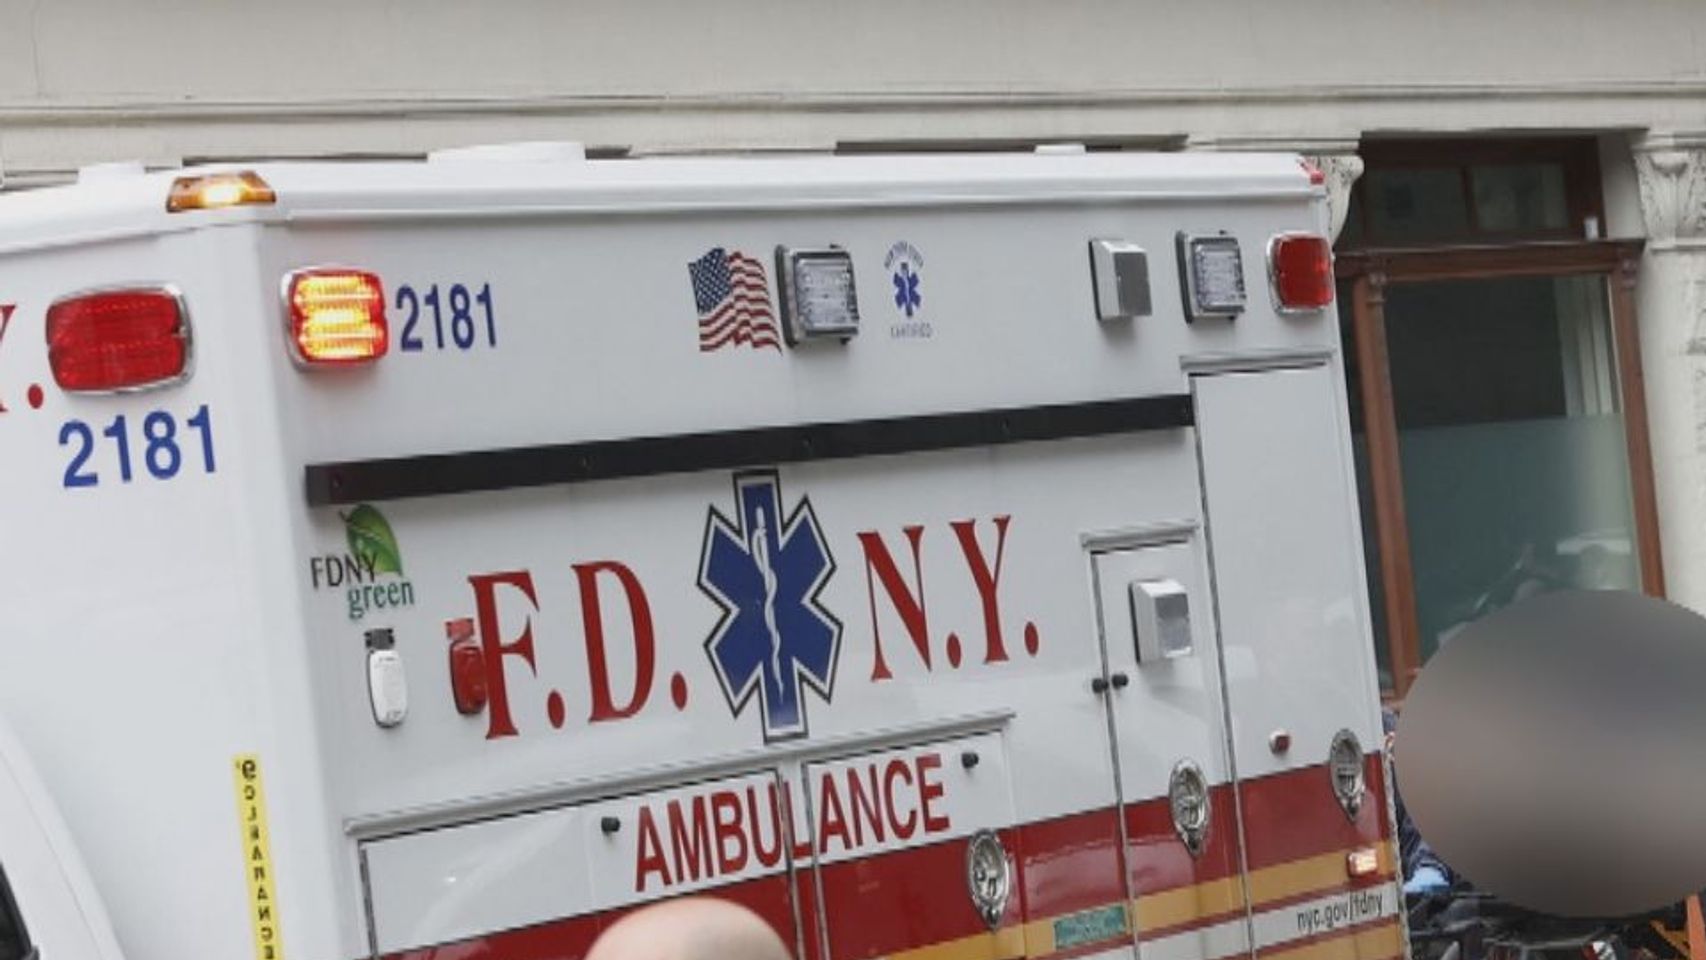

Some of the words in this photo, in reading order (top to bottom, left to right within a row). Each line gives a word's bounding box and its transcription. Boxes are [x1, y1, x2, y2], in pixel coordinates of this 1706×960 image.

[396, 283, 496, 352] 2181
[59, 405, 215, 488] 2181
[310, 553, 378, 590] FDNY
[348, 581, 415, 620] green
[468, 559, 690, 740] F.D.
[857, 514, 1039, 682] N.Y.
[634, 753, 951, 893] AMBULANCE
